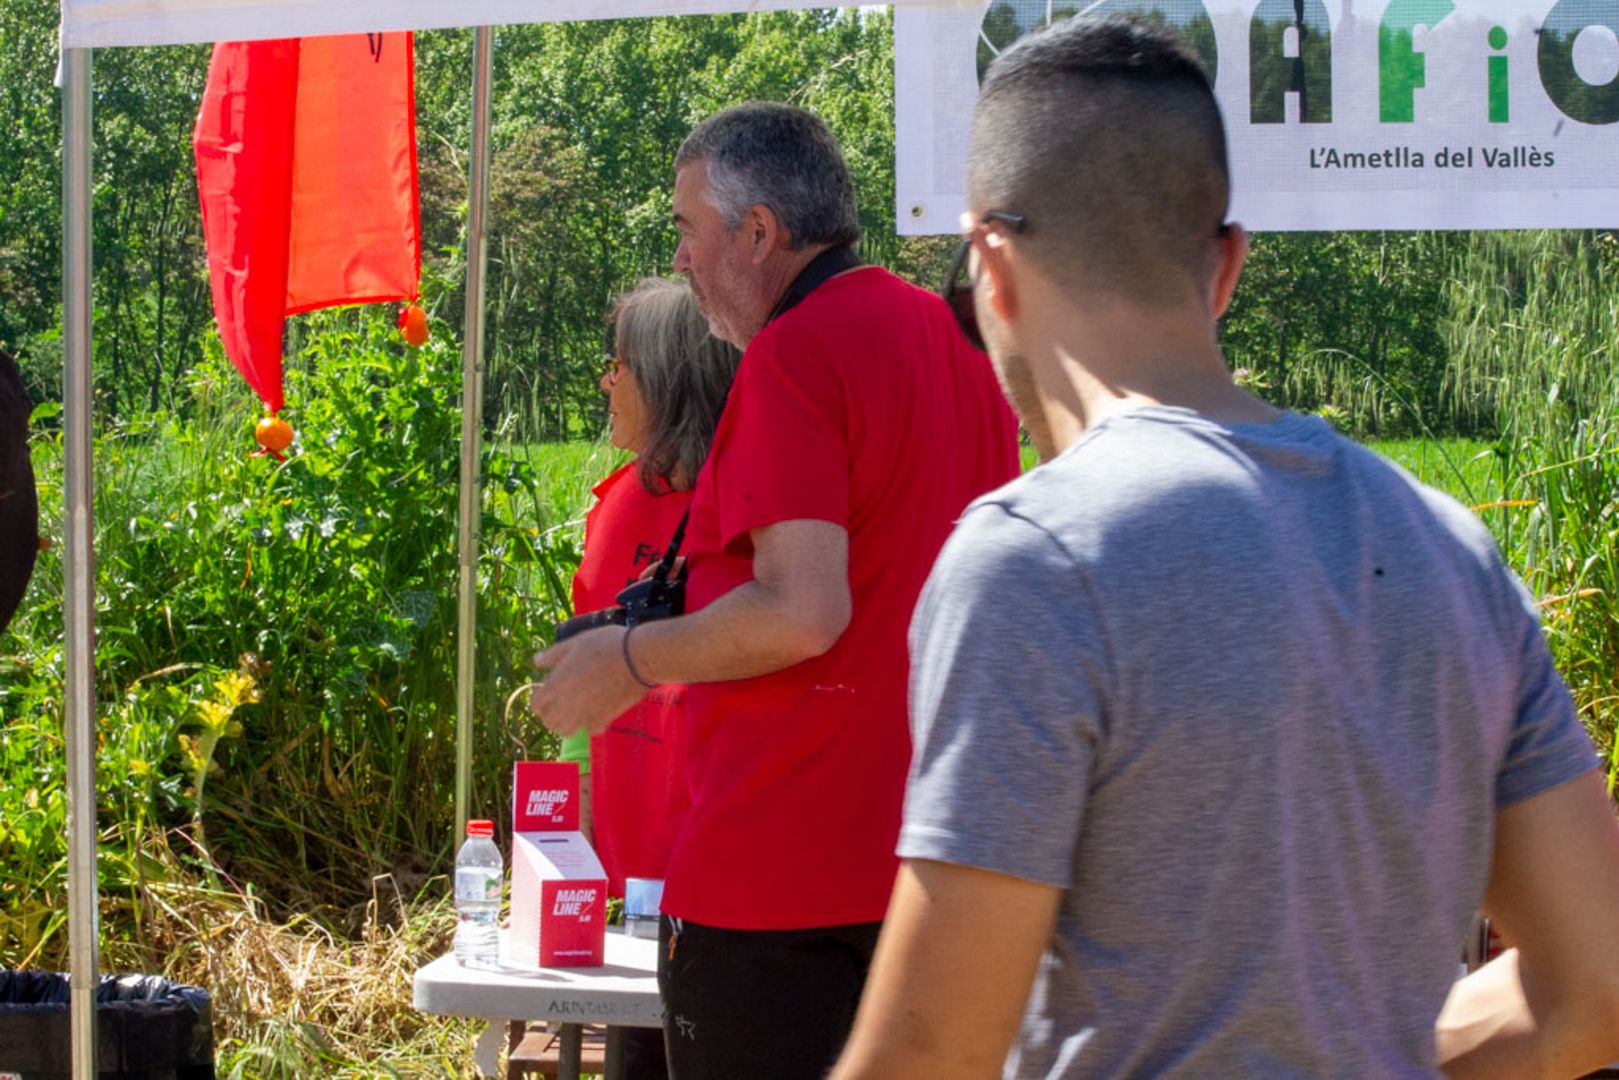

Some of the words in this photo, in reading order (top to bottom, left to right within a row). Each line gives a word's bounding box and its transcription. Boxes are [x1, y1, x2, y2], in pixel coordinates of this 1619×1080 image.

[1309, 147, 1425, 169] L'Ametlla
[1434, 147, 1473, 169] del
[1482, 145, 1555, 169] Vallès
[529, 789, 569, 804] MAGIC
[525, 803, 555, 816] LINE
[556, 889, 597, 903] MAGIC
[552, 902, 582, 916] LINE
